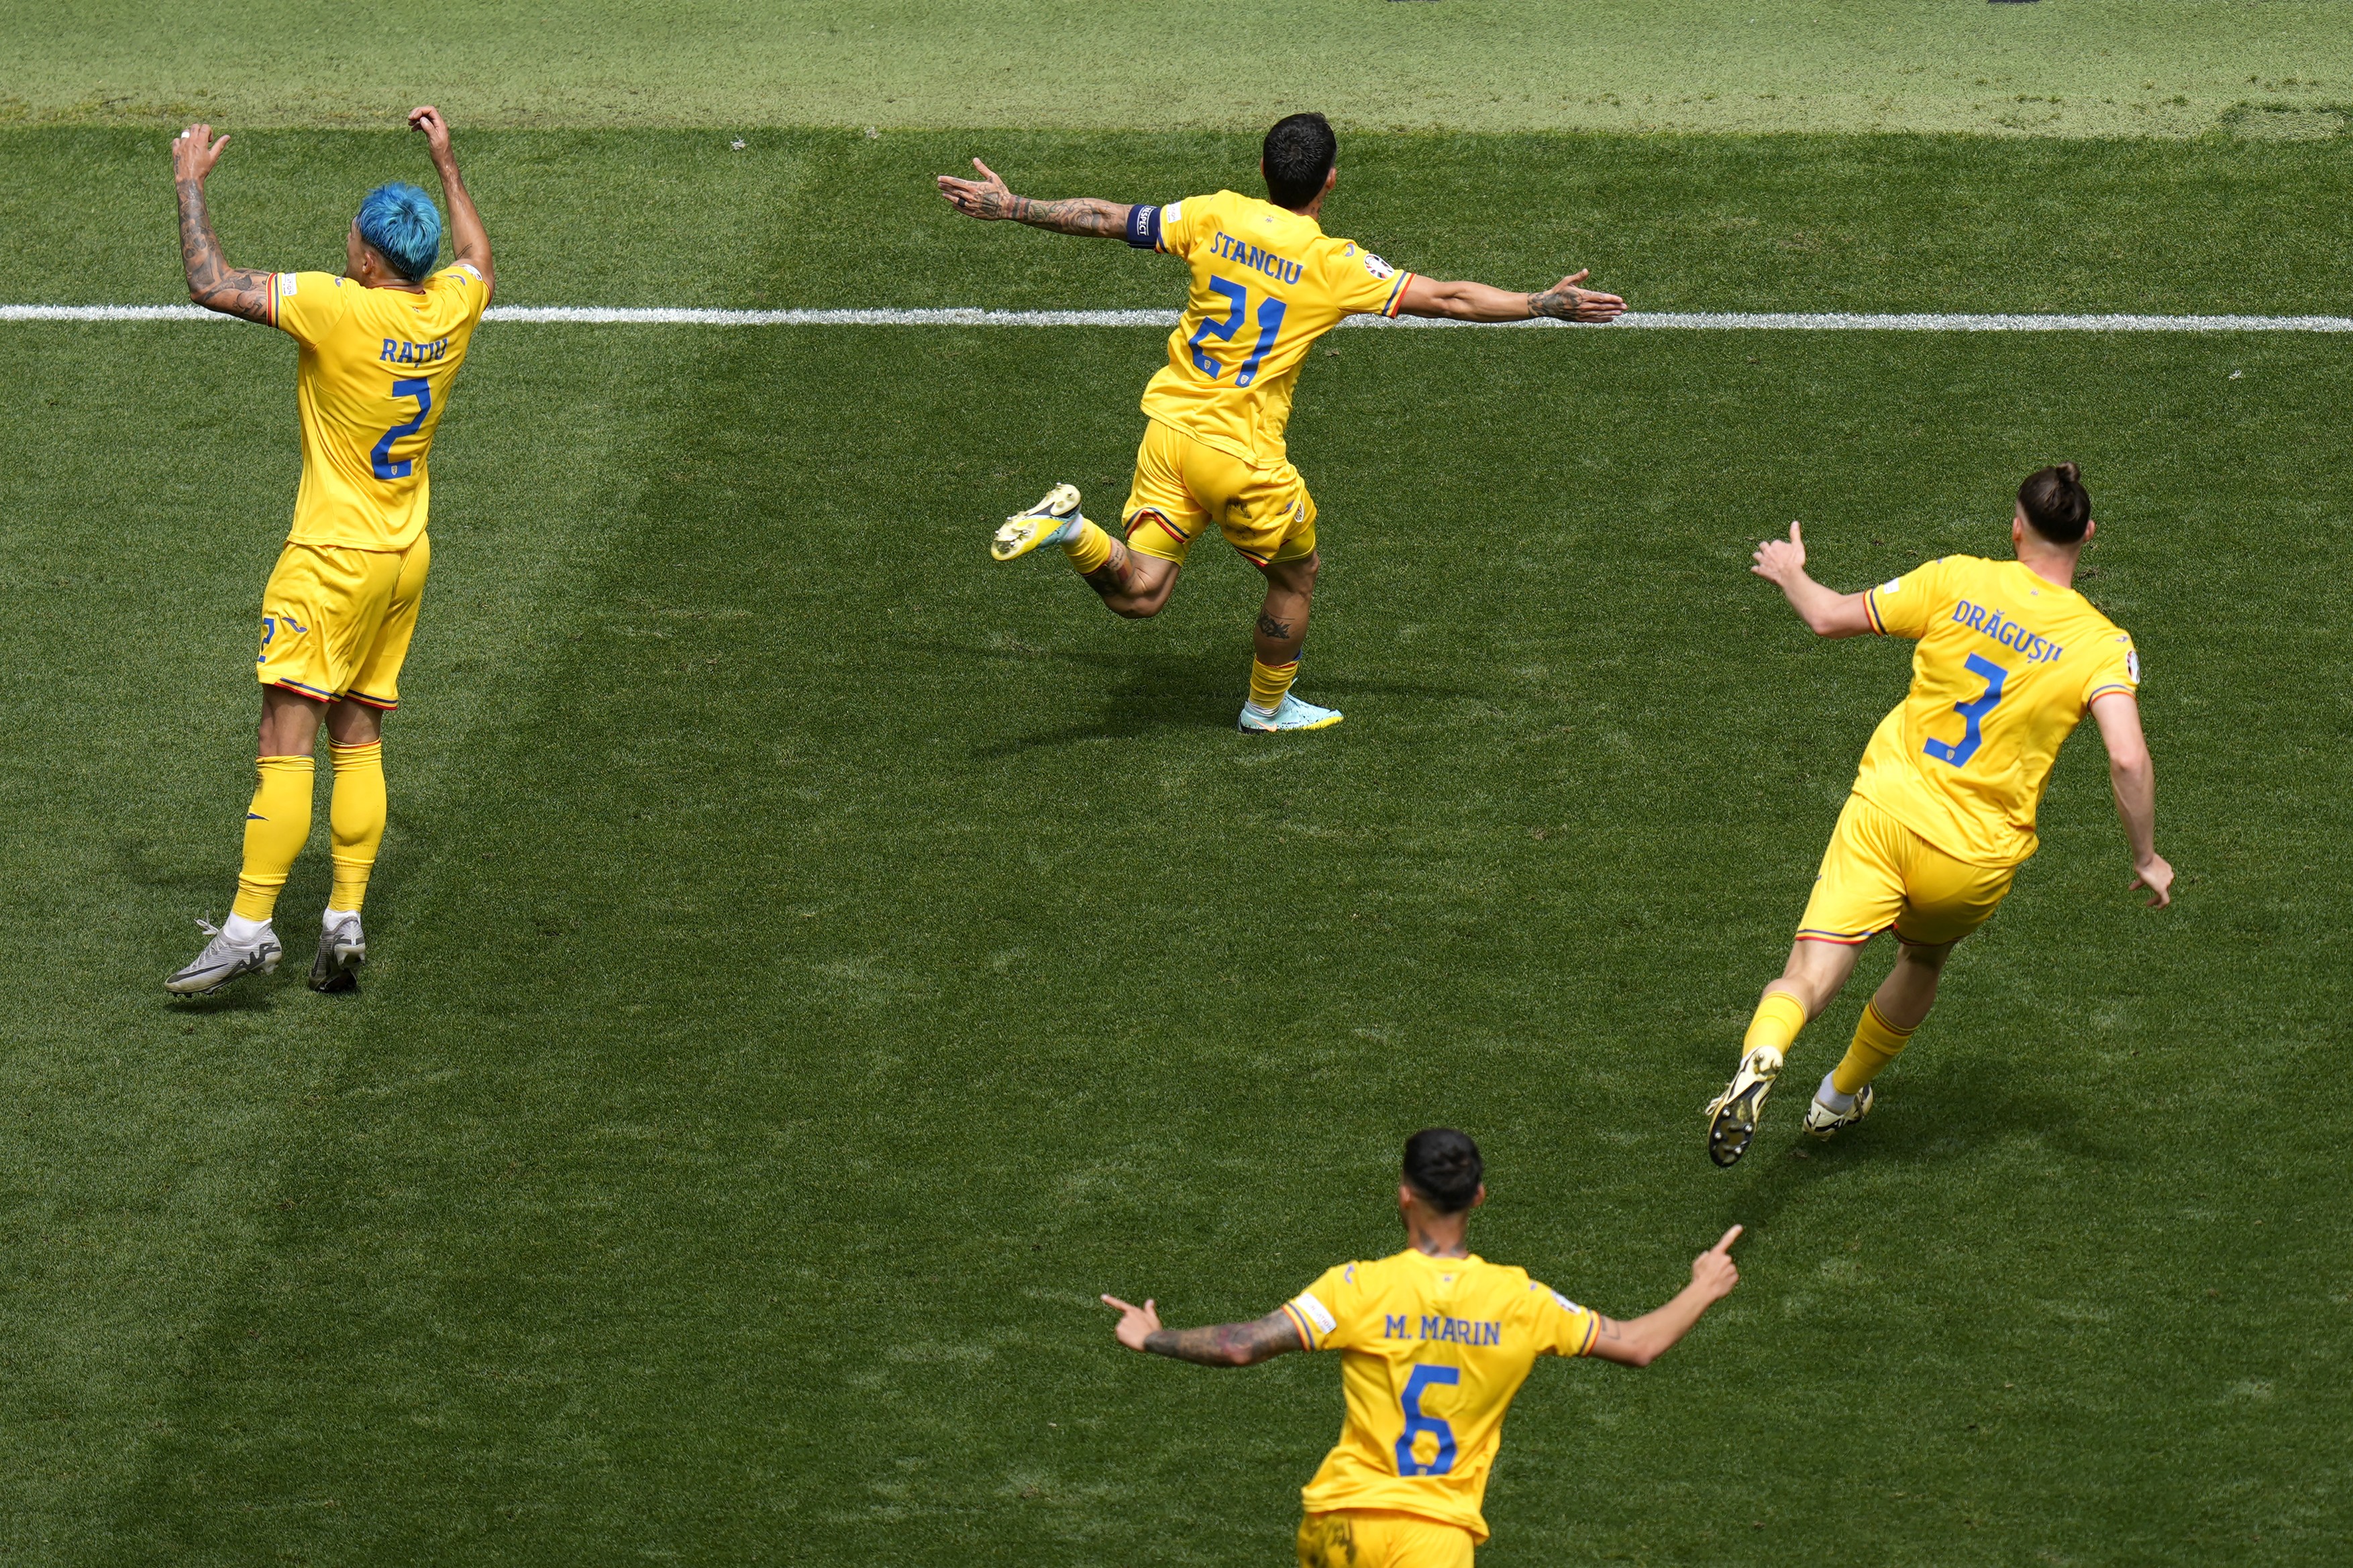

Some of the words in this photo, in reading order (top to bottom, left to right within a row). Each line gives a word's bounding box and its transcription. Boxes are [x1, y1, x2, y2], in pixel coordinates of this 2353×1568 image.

[1139, 207, 1152, 236] RESPECT
[1210, 231, 1304, 284] STANCIU
[379, 338, 448, 368] RAȚIU
[1188, 274, 1287, 388] 21
[370, 377, 431, 479] 2
[1923, 653, 2008, 768] 3
[1384, 1314, 1412, 1339] M.
[1420, 1315, 1501, 1345] MARIN
[1396, 1363, 1459, 1476] 6
